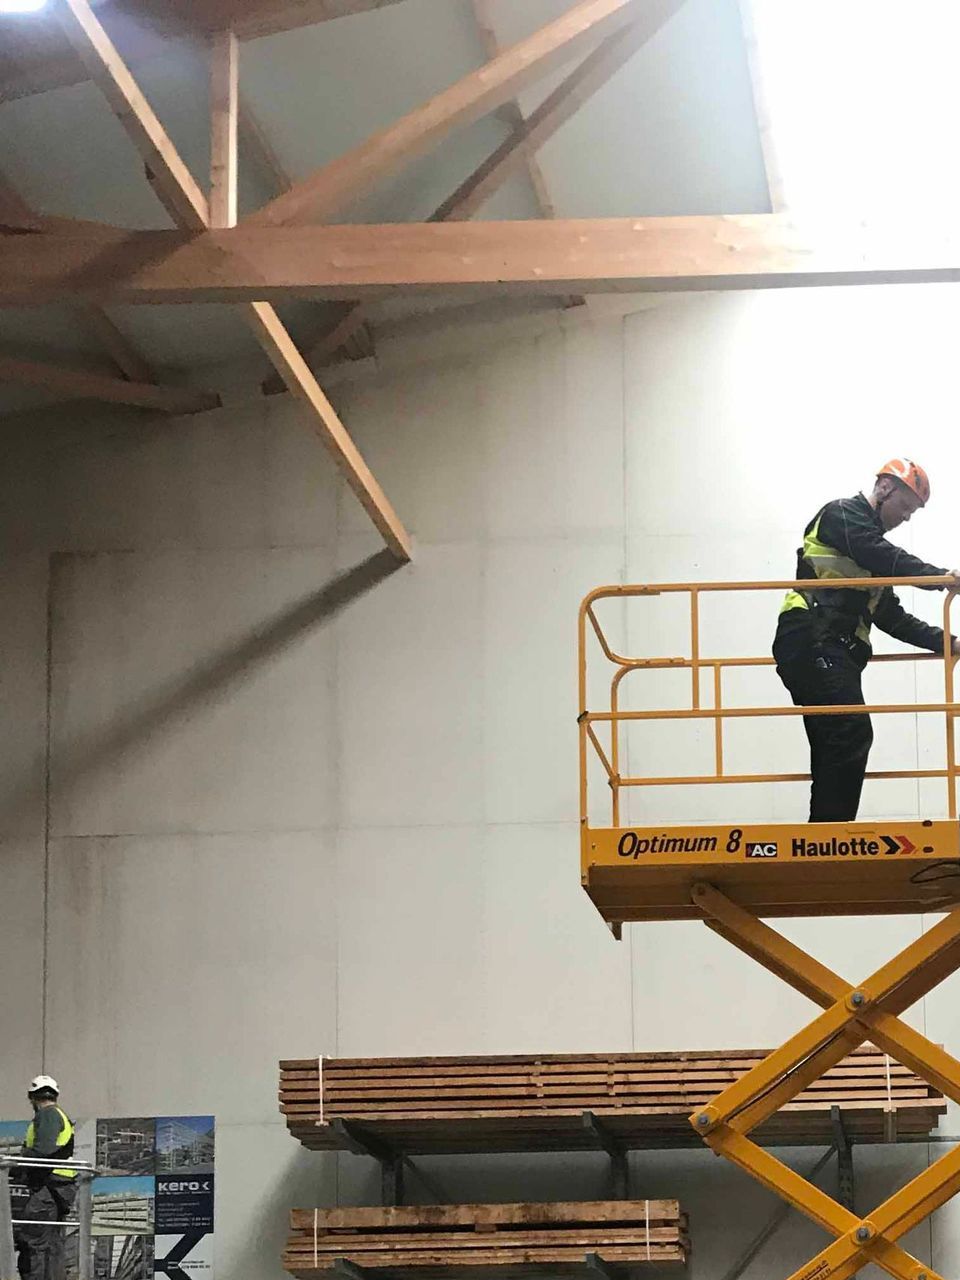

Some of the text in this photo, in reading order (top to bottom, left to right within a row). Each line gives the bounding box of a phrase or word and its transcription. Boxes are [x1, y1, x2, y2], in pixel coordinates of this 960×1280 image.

[618, 829, 743, 859] Optimum 8
[791, 837, 879, 857] Haulotte
